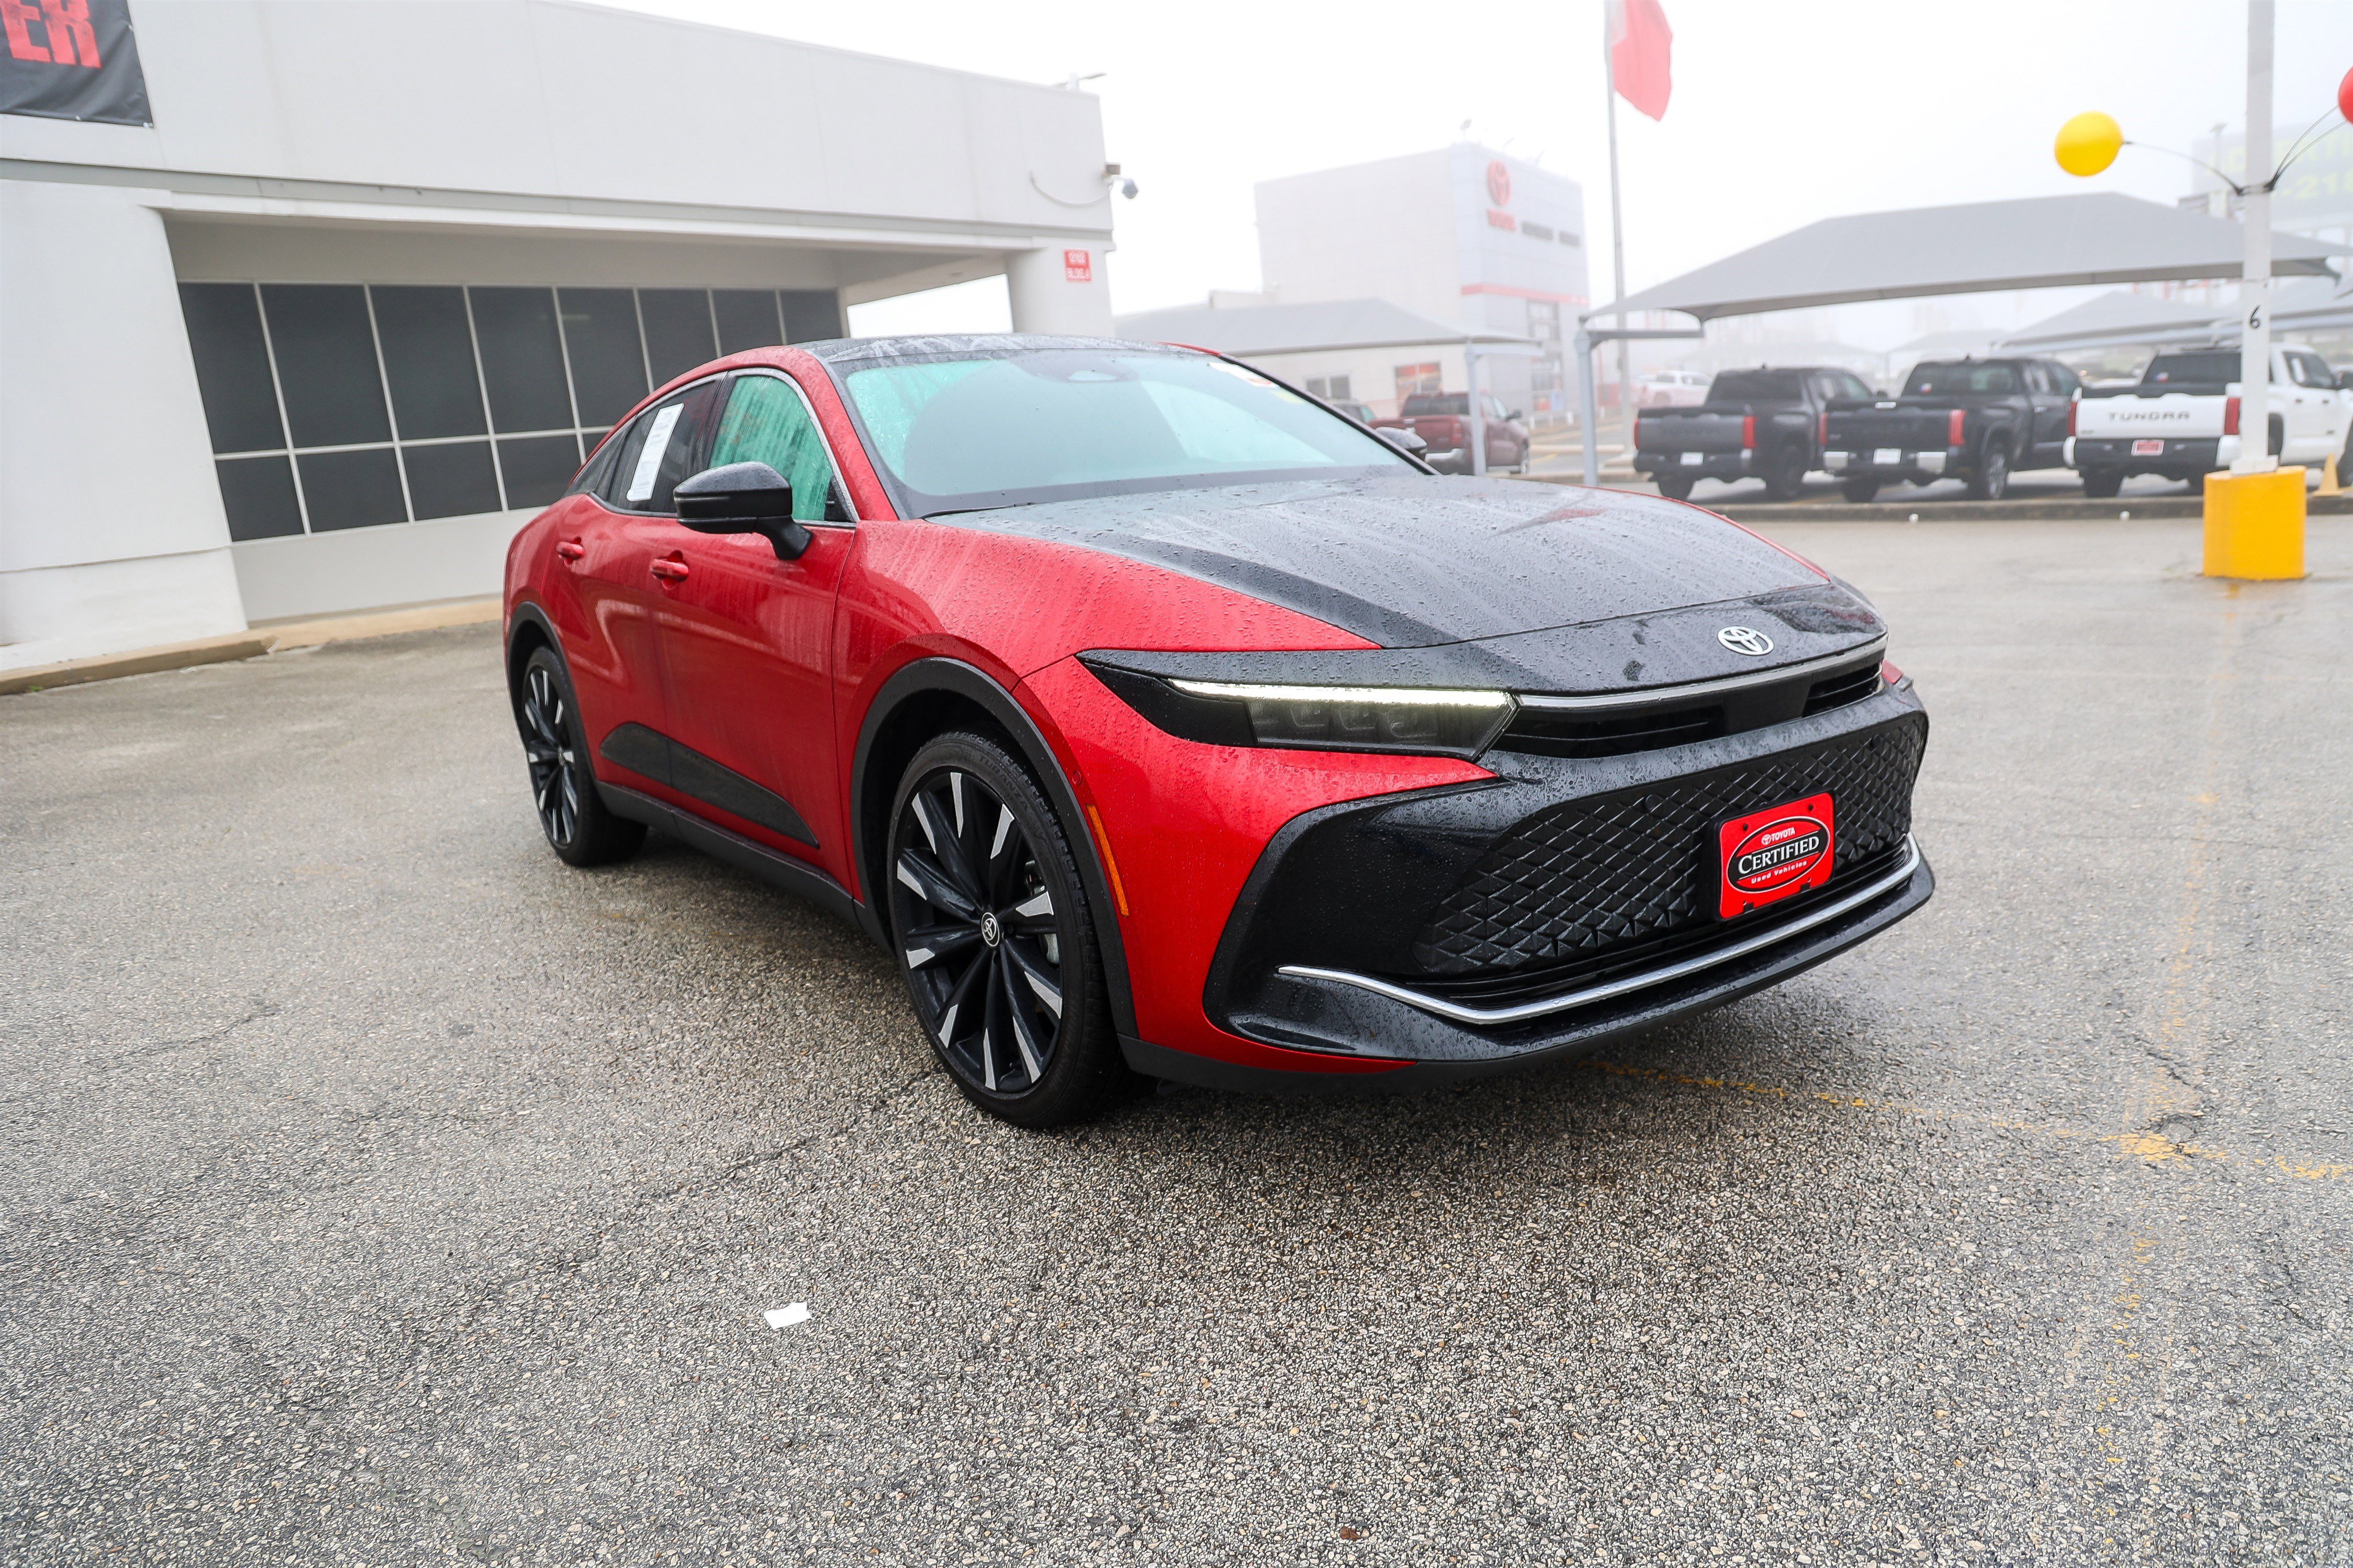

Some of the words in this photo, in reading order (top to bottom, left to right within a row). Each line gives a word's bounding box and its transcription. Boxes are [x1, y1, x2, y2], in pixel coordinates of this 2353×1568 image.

[2248, 304, 2261, 329] 6
[2108, 411, 2190, 421] TUNDRA
[979, 754, 1029, 812] TURANZA
[1771, 827, 1795, 841] TOYOTA
[1751, 872, 1772, 884] Used
[1774, 860, 1807, 876] Vehicles
